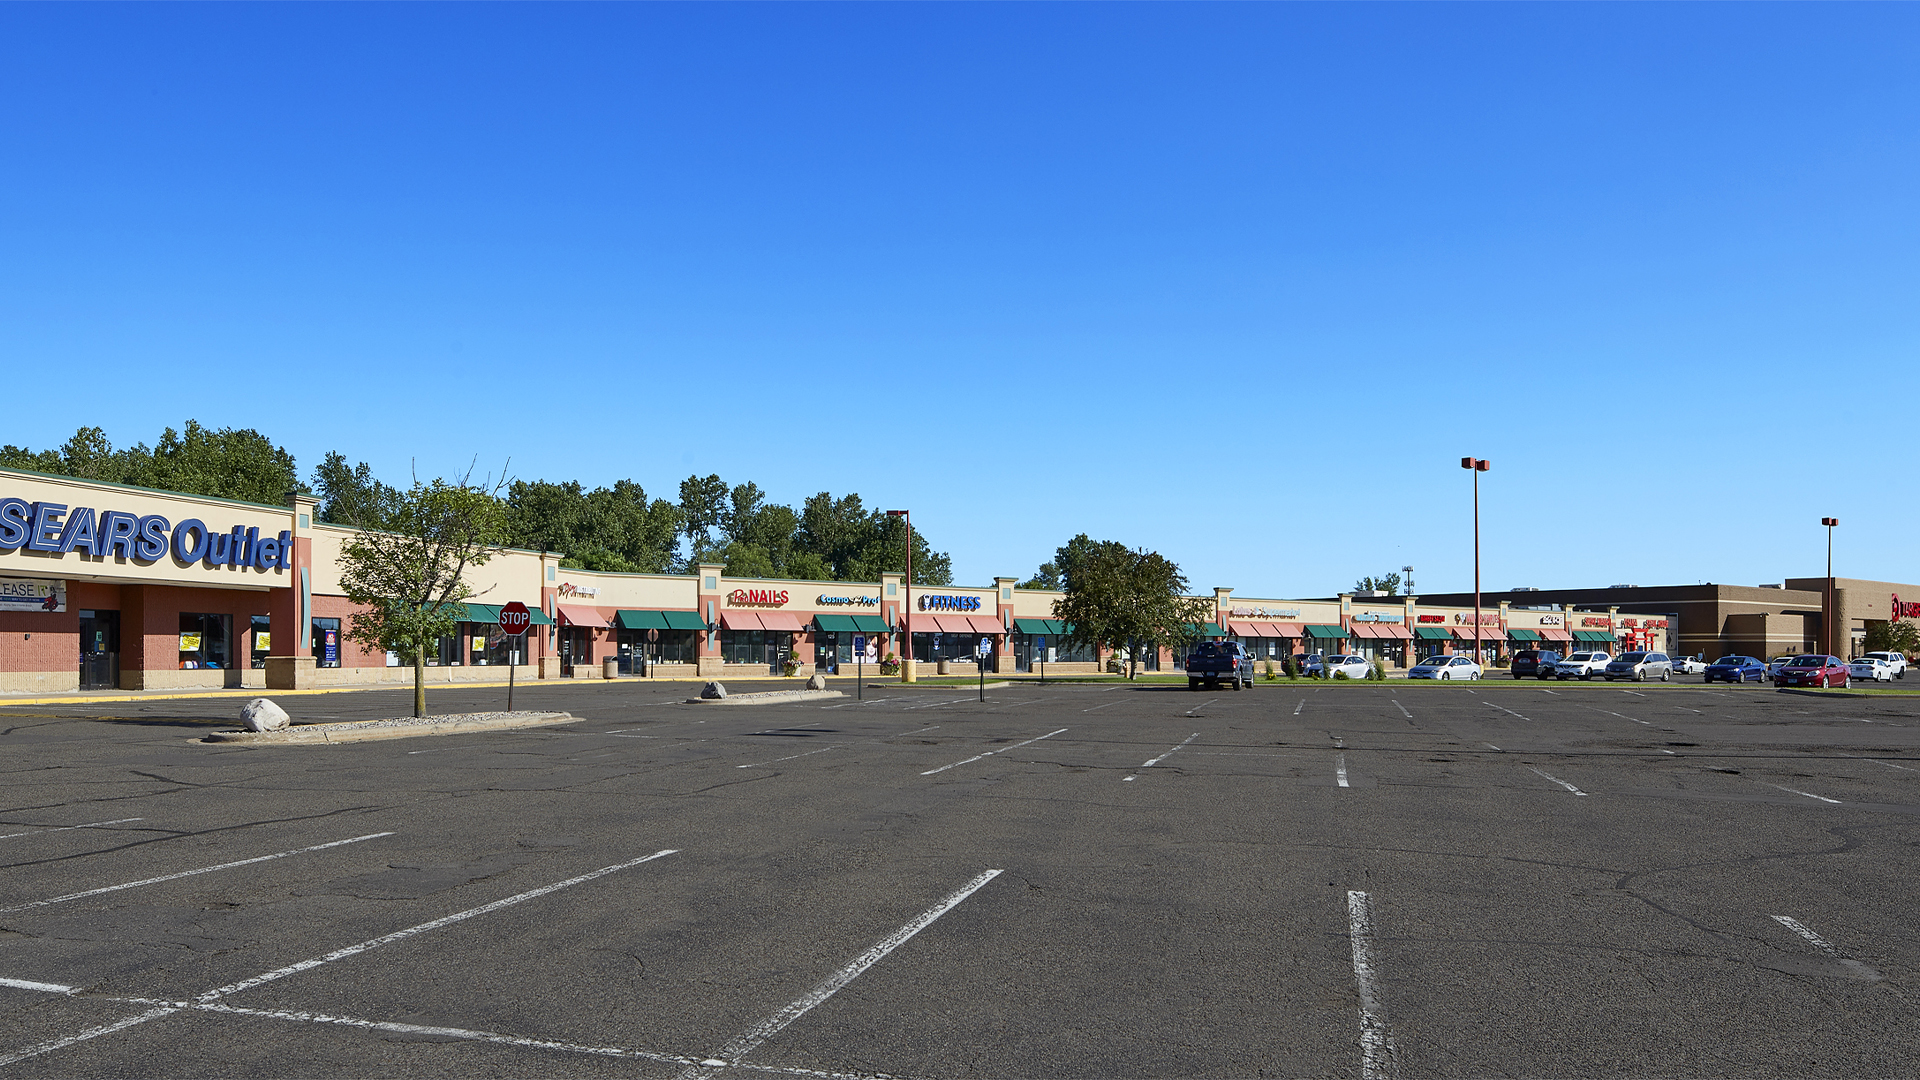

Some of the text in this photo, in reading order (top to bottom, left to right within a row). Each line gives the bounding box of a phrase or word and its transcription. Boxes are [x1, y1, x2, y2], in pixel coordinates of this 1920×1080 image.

[0, 498, 293, 570] SEARS Outlet
[749, 589, 789, 604] NAILS
[820, 594, 881, 604] Cosmo Prof
[932, 595, 981, 609] FITNESS
[501, 612, 529, 625] STOP
